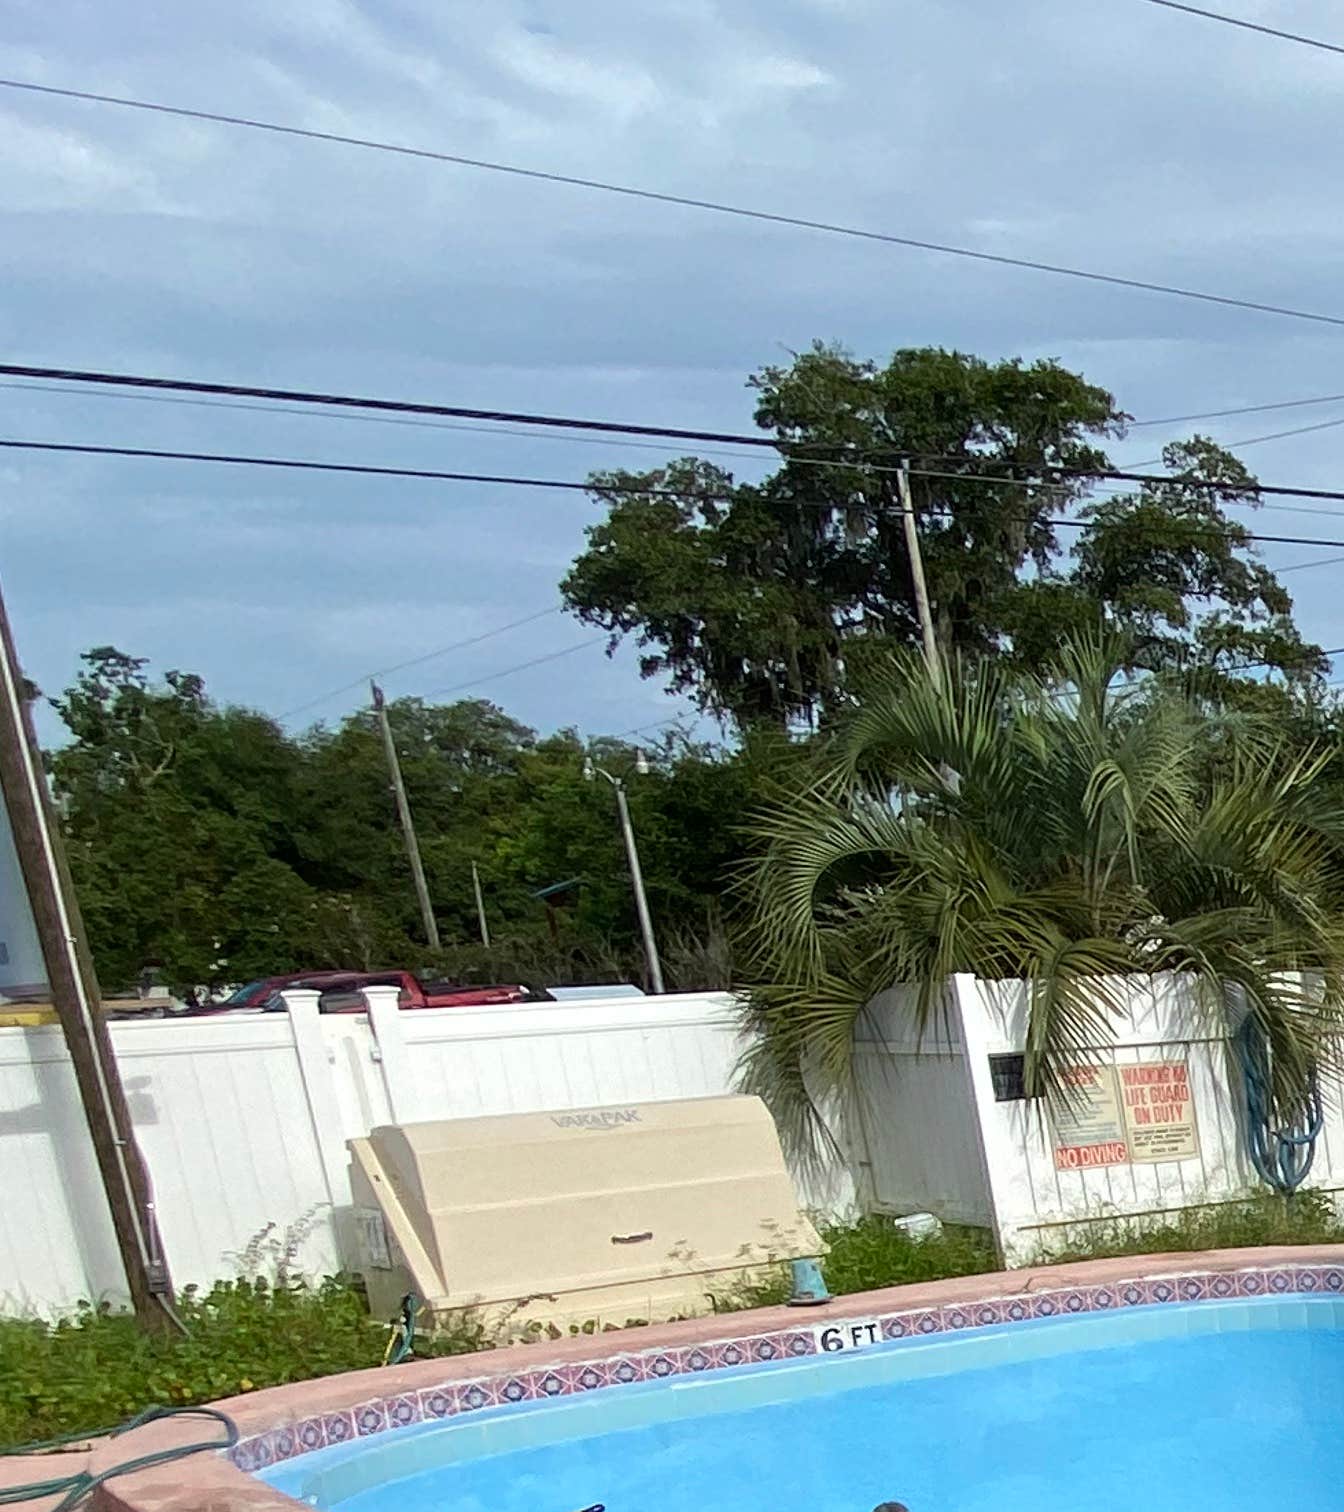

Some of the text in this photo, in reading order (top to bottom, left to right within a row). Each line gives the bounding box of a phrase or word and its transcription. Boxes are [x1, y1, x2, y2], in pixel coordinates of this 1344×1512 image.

[1120, 1065, 1170, 1086] WARNING
[1124, 1088, 1148, 1107] LIFE
[1149, 1084, 1189, 1103] GUARD
[1134, 1107, 1151, 1124] ON
[1153, 1103, 1183, 1123] DUTY
[1057, 1148, 1079, 1168] NO
[1080, 1142, 1127, 1165] DIVING
[820, 1327, 844, 1352] 6
